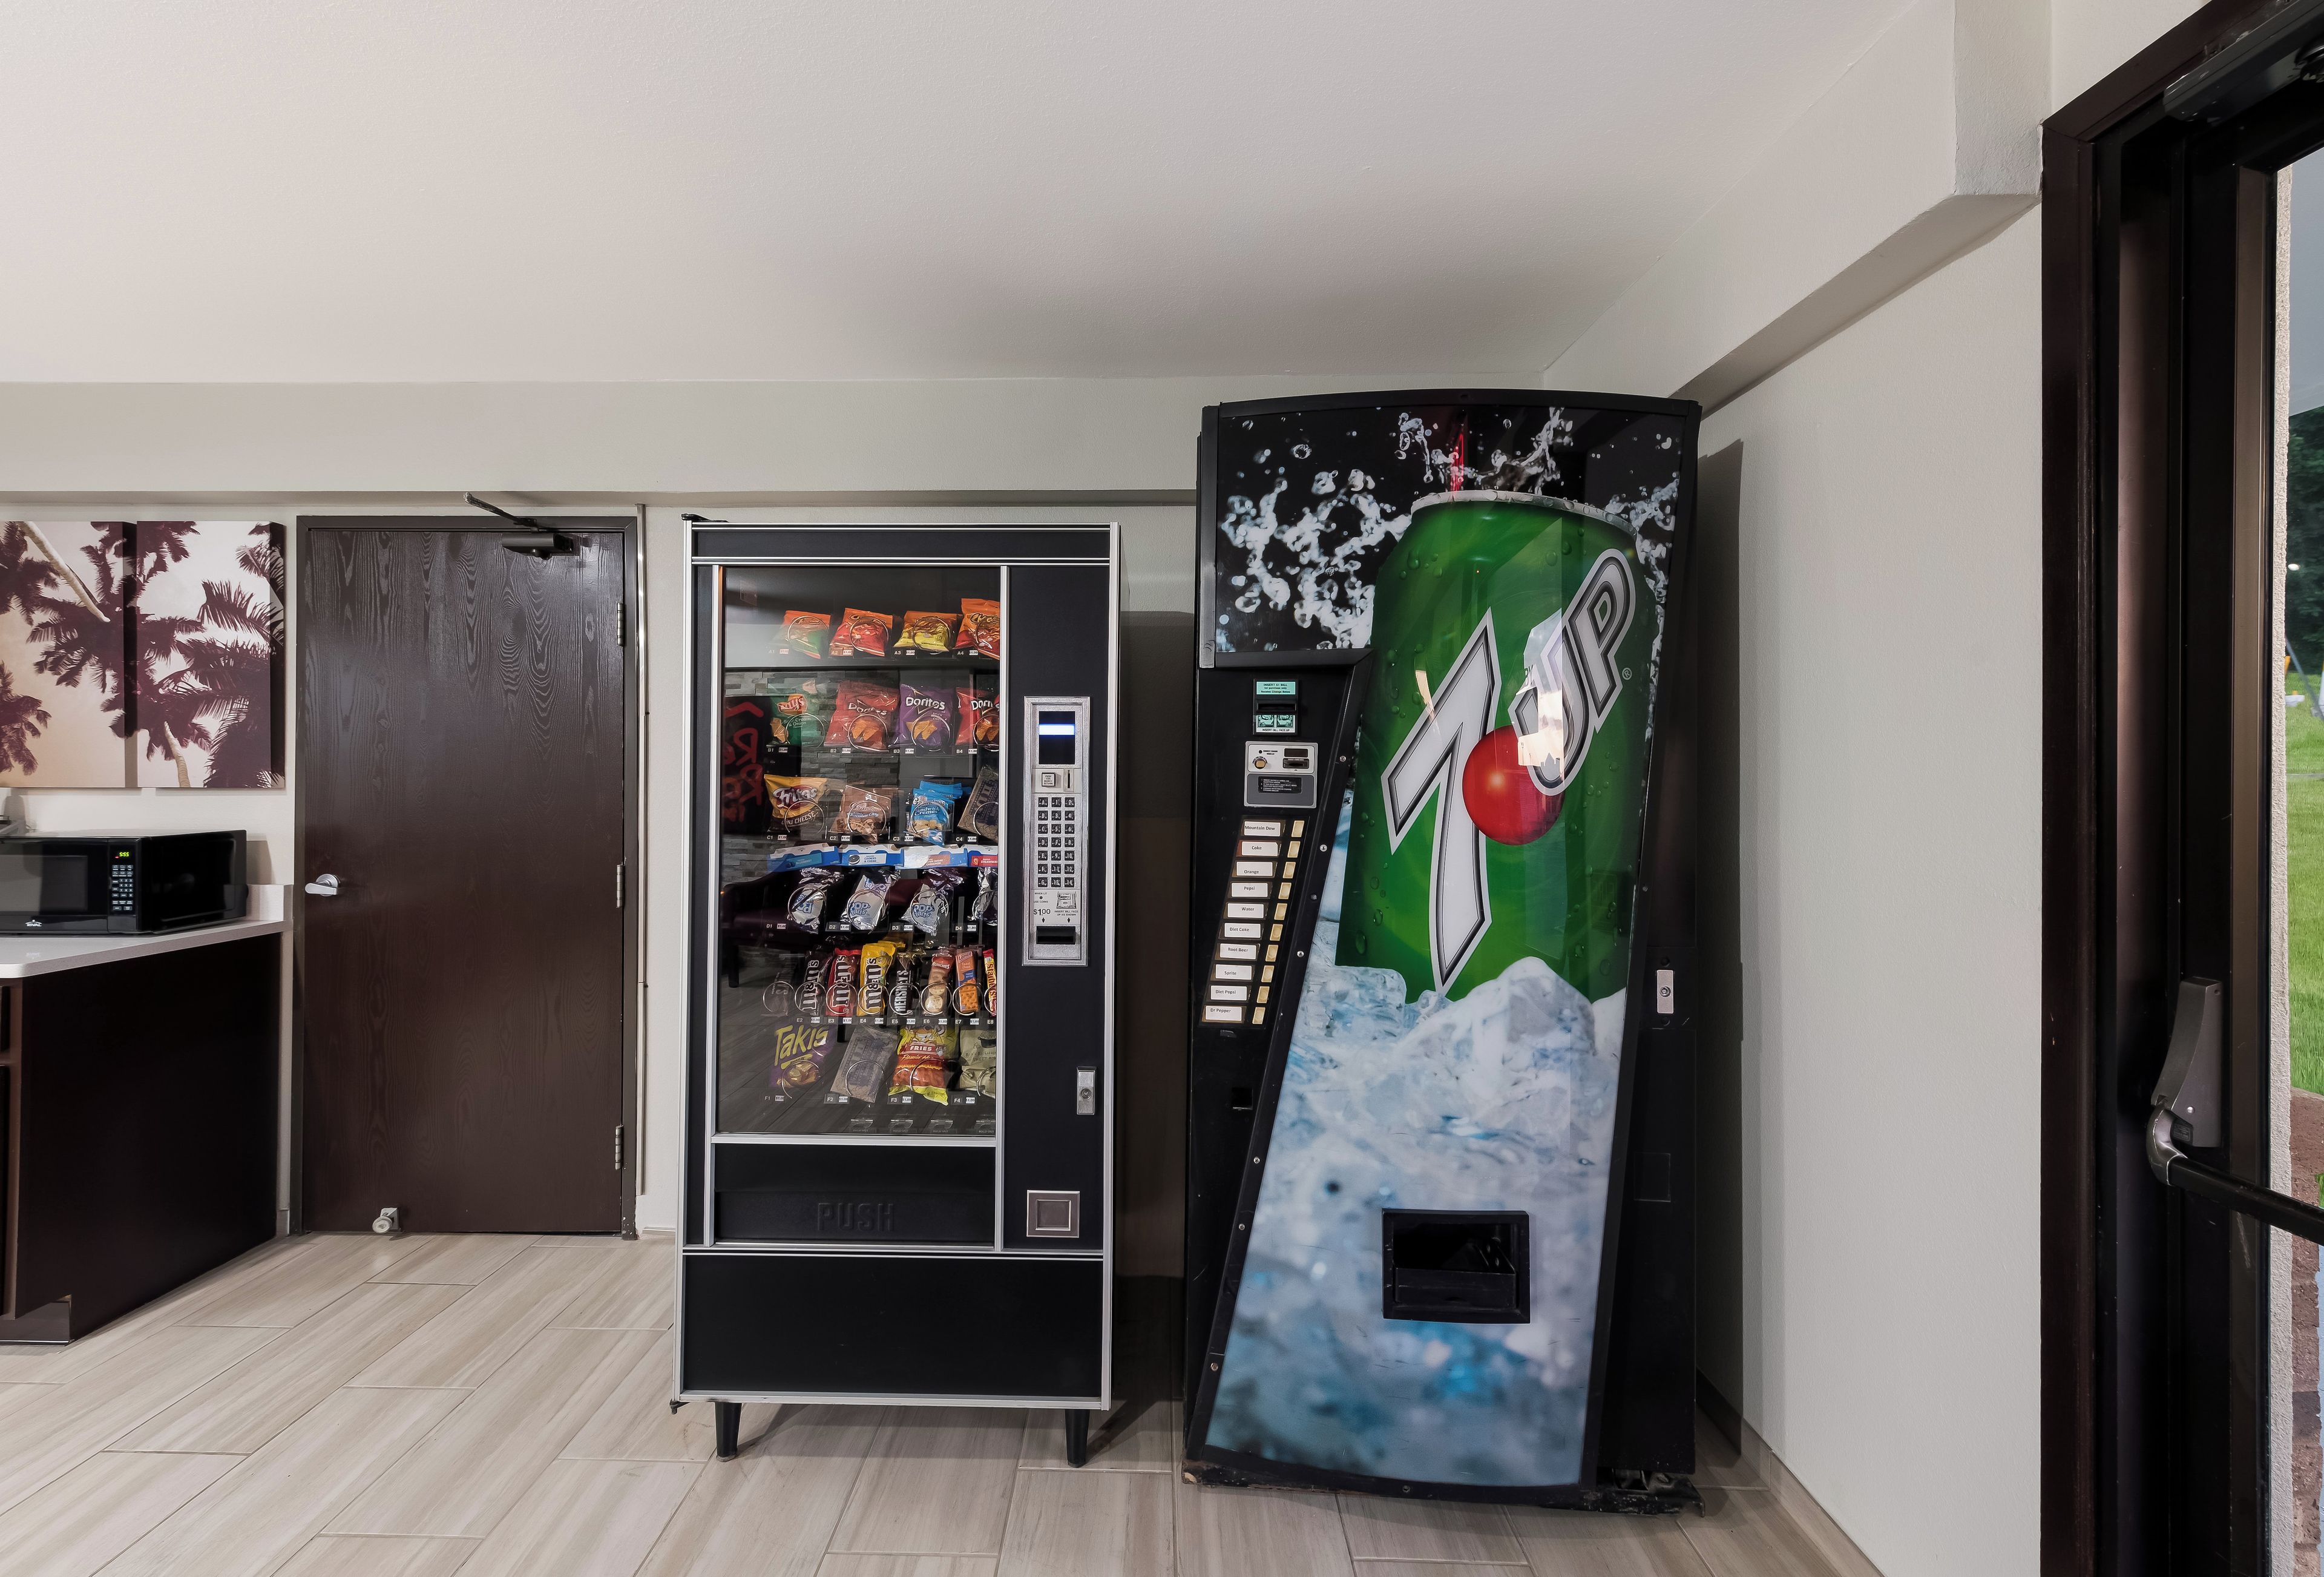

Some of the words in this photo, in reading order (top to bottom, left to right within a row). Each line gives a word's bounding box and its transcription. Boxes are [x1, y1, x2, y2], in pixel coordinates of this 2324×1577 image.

[906, 697, 945, 710] Doritos
[773, 787, 817, 806] Fritos
[794, 812, 815, 824] CHEESE
[959, 951, 972, 961] Lance
[774, 1025, 829, 1066] Takis
[818, 1203, 894, 1231] PUSH
